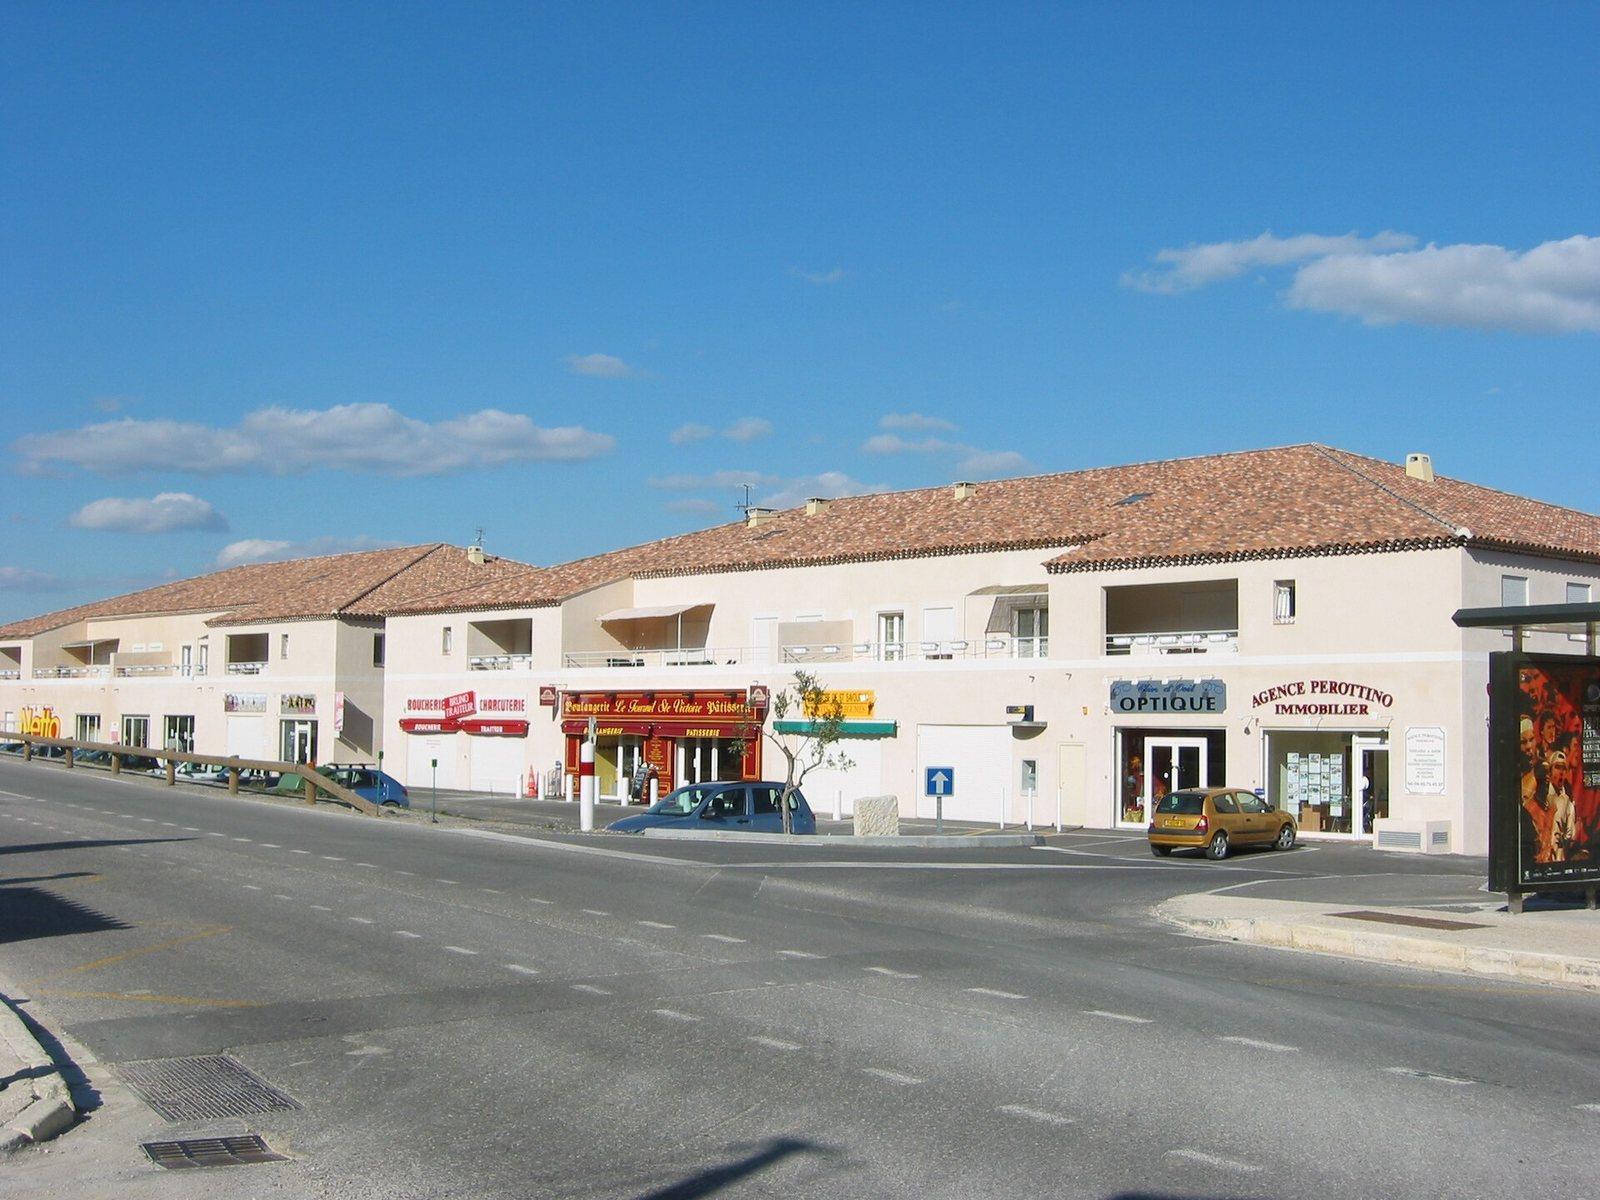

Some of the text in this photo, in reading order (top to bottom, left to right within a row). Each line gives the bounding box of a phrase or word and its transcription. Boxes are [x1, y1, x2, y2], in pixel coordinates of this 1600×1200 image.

[1252, 680, 1394, 708] AGENCE PEROTTINO
[407, 699, 446, 711] BOUCHERIE
[479, 699, 525, 712] CHARCUTERIE
[564, 700, 610, 713] Boulangerie
[1119, 696, 1216, 712] OPTIQUE
[1274, 703, 1370, 716] IMMOBILIER
[20, 706, 62, 739] Netto
